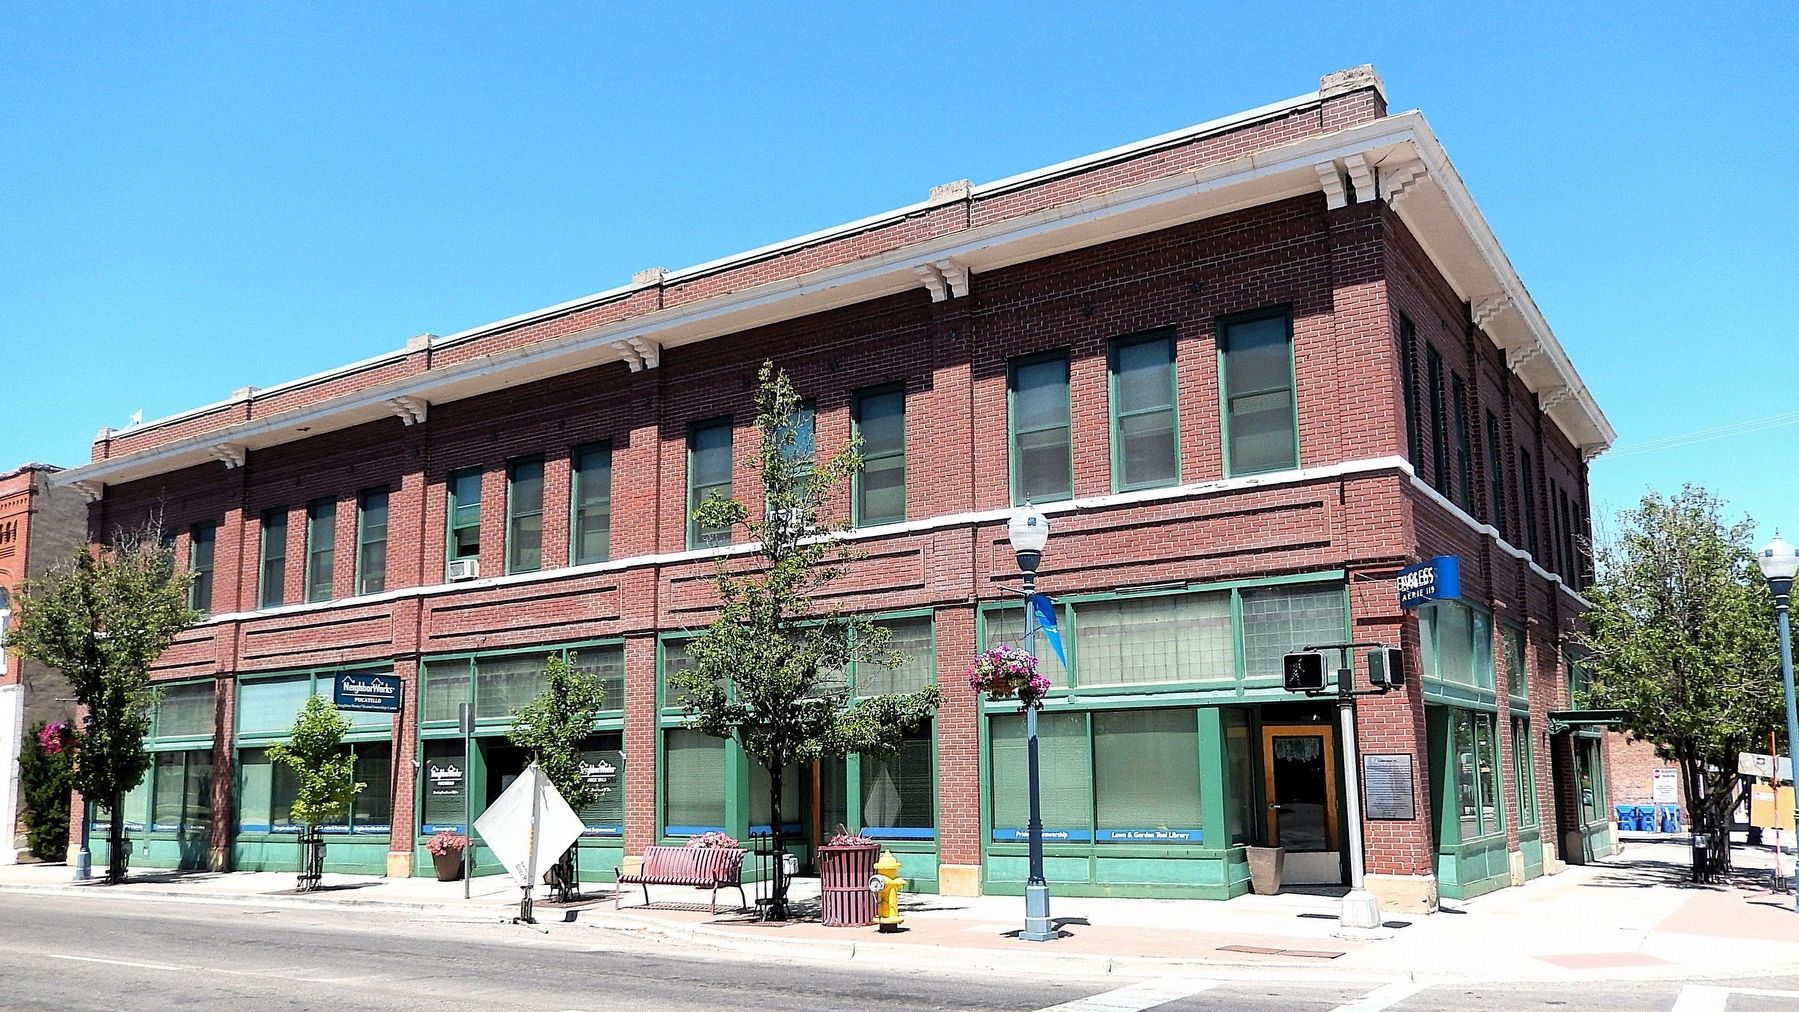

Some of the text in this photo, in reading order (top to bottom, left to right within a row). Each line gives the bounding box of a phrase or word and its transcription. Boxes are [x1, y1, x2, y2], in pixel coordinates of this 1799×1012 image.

[1397, 567, 1434, 592] EAGLES
[1402, 586, 1435, 602] AERIE 119
[1168, 831, 1190, 840] Library
